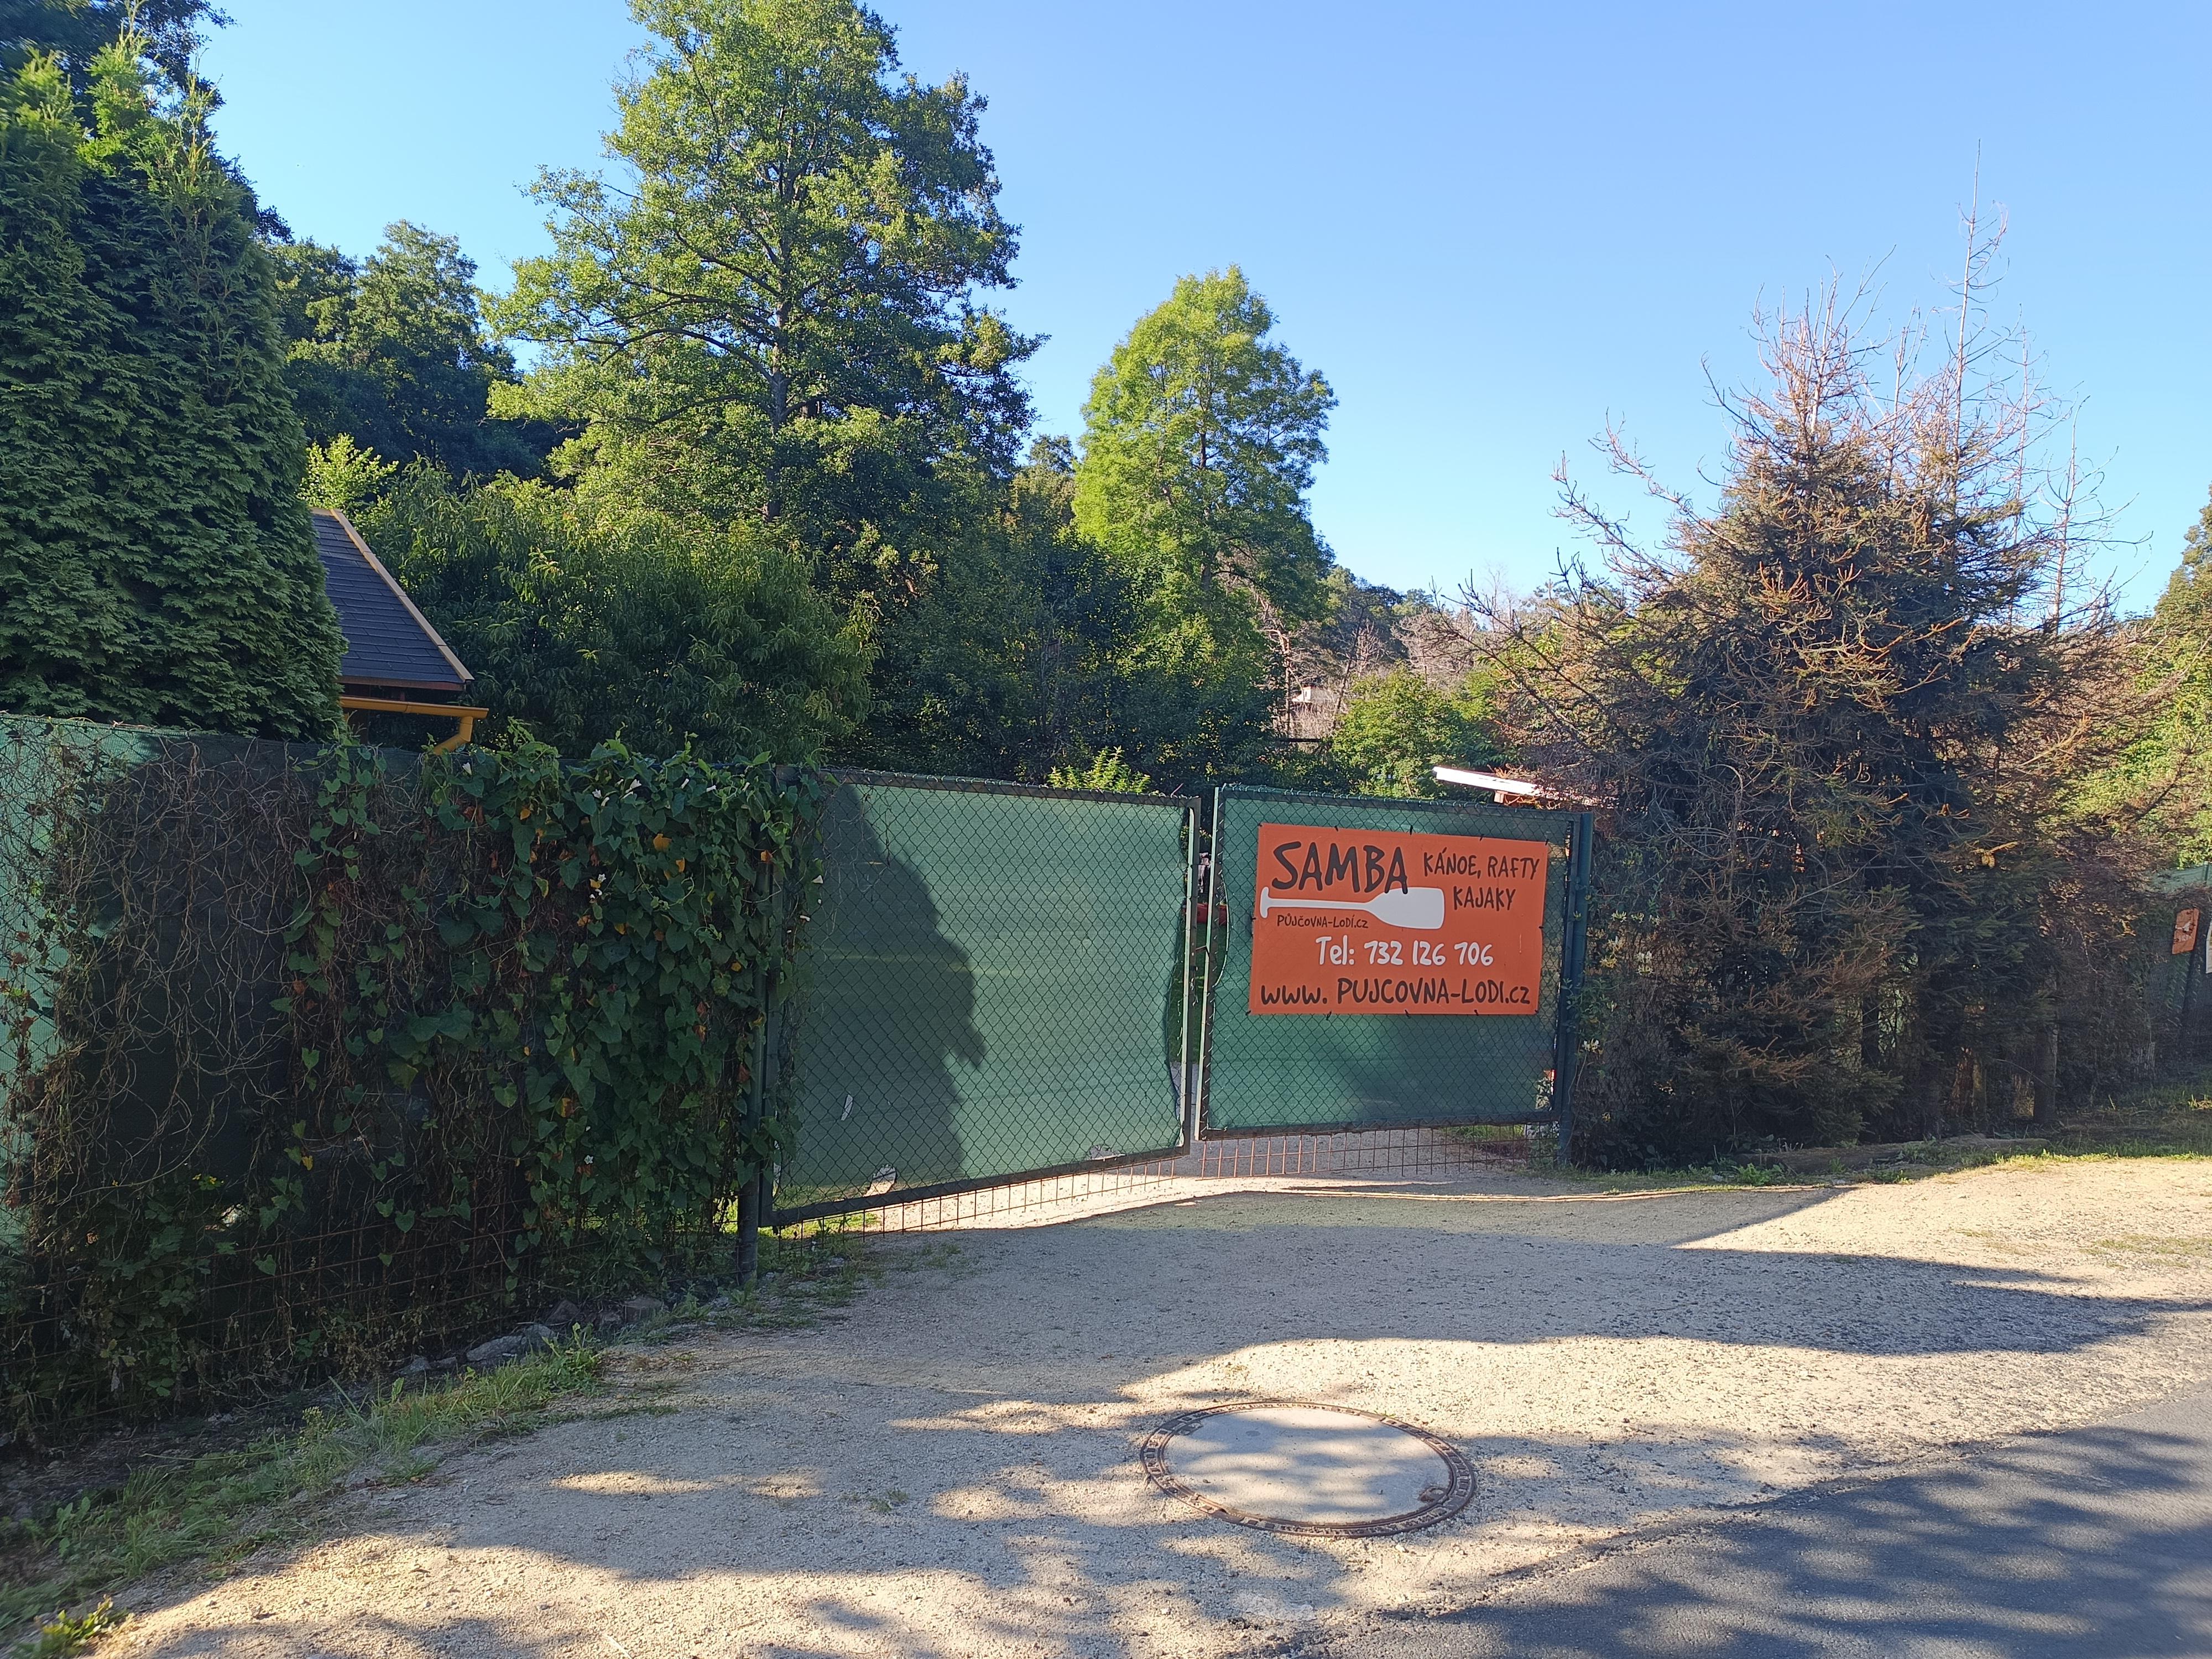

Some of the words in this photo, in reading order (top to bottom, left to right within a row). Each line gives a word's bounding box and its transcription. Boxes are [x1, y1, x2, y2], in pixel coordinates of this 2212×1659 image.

[1272, 841, 1408, 894] SAMBA
[1423, 847, 1481, 879] KÁNOE,
[1488, 855, 1540, 880] RAFTY
[1453, 885, 1516, 911] KAJAKY
[1316, 935, 1355, 965] Tel:
[1364, 941, 1404, 965] 732
[1412, 941, 1446, 966] 126
[1454, 942, 1494, 966] 706
